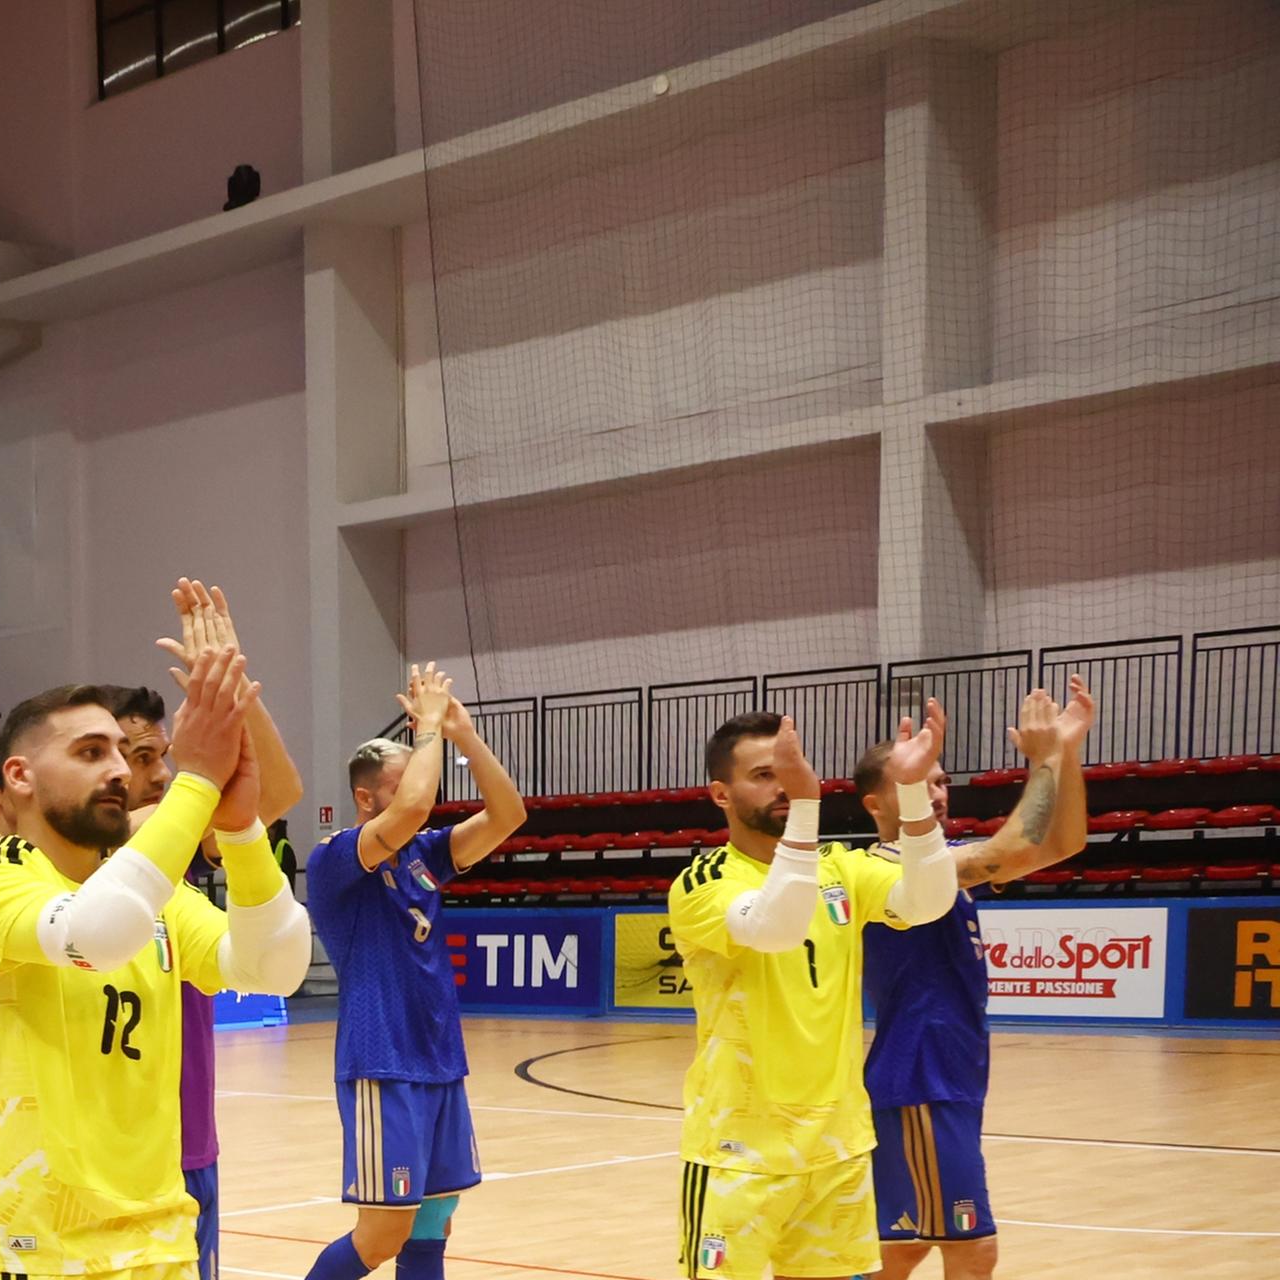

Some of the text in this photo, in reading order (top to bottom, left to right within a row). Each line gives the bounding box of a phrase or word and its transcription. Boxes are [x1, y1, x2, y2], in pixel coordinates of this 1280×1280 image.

[476, 934, 579, 988] TIM
[804, 938, 819, 989] 1
[1010, 946, 1055, 969] dello
[1057, 934, 1153, 980] Sport
[1036, 981, 1104, 995] PASSIONE
[101, 984, 141, 1060] 12
